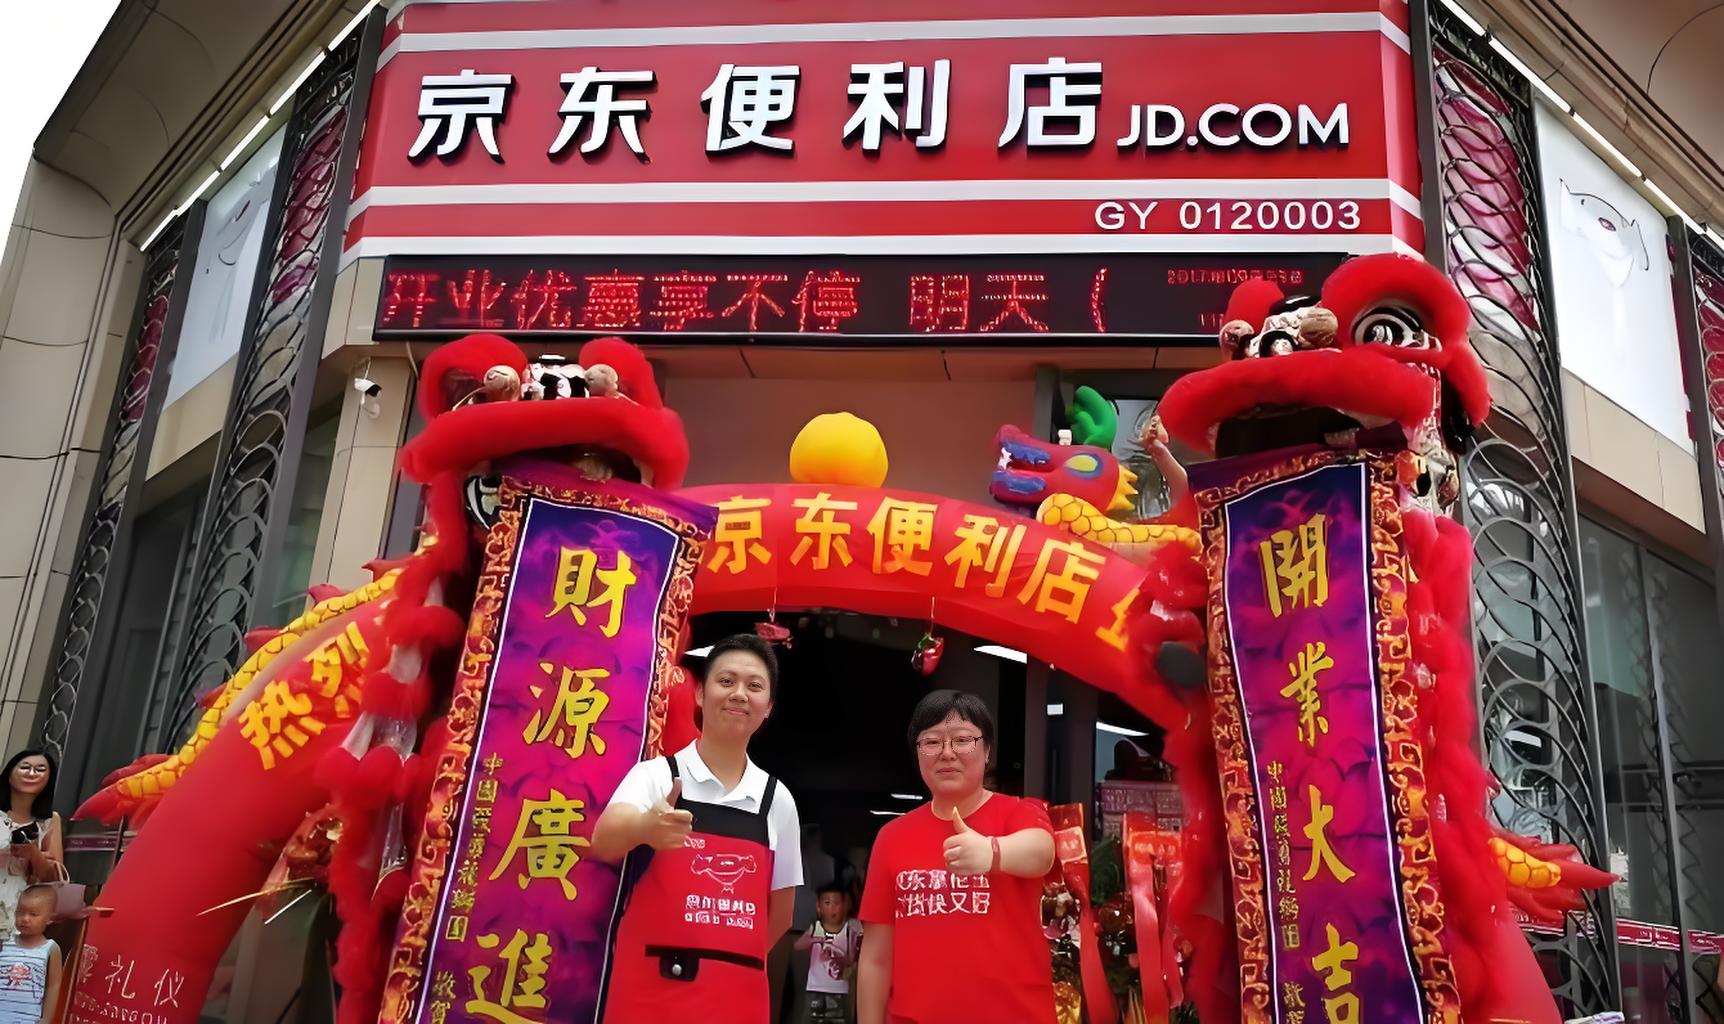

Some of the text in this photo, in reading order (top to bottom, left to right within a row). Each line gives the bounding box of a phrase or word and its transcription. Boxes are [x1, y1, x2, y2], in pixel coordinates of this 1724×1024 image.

[408, 57, 1349, 157] 京东便利店 JD.COM
[1095, 201, 1361, 230] GY 0120003
[464, 545, 638, 1024] 財源廣進
[1259, 512, 1360, 1024] 開業大吉
